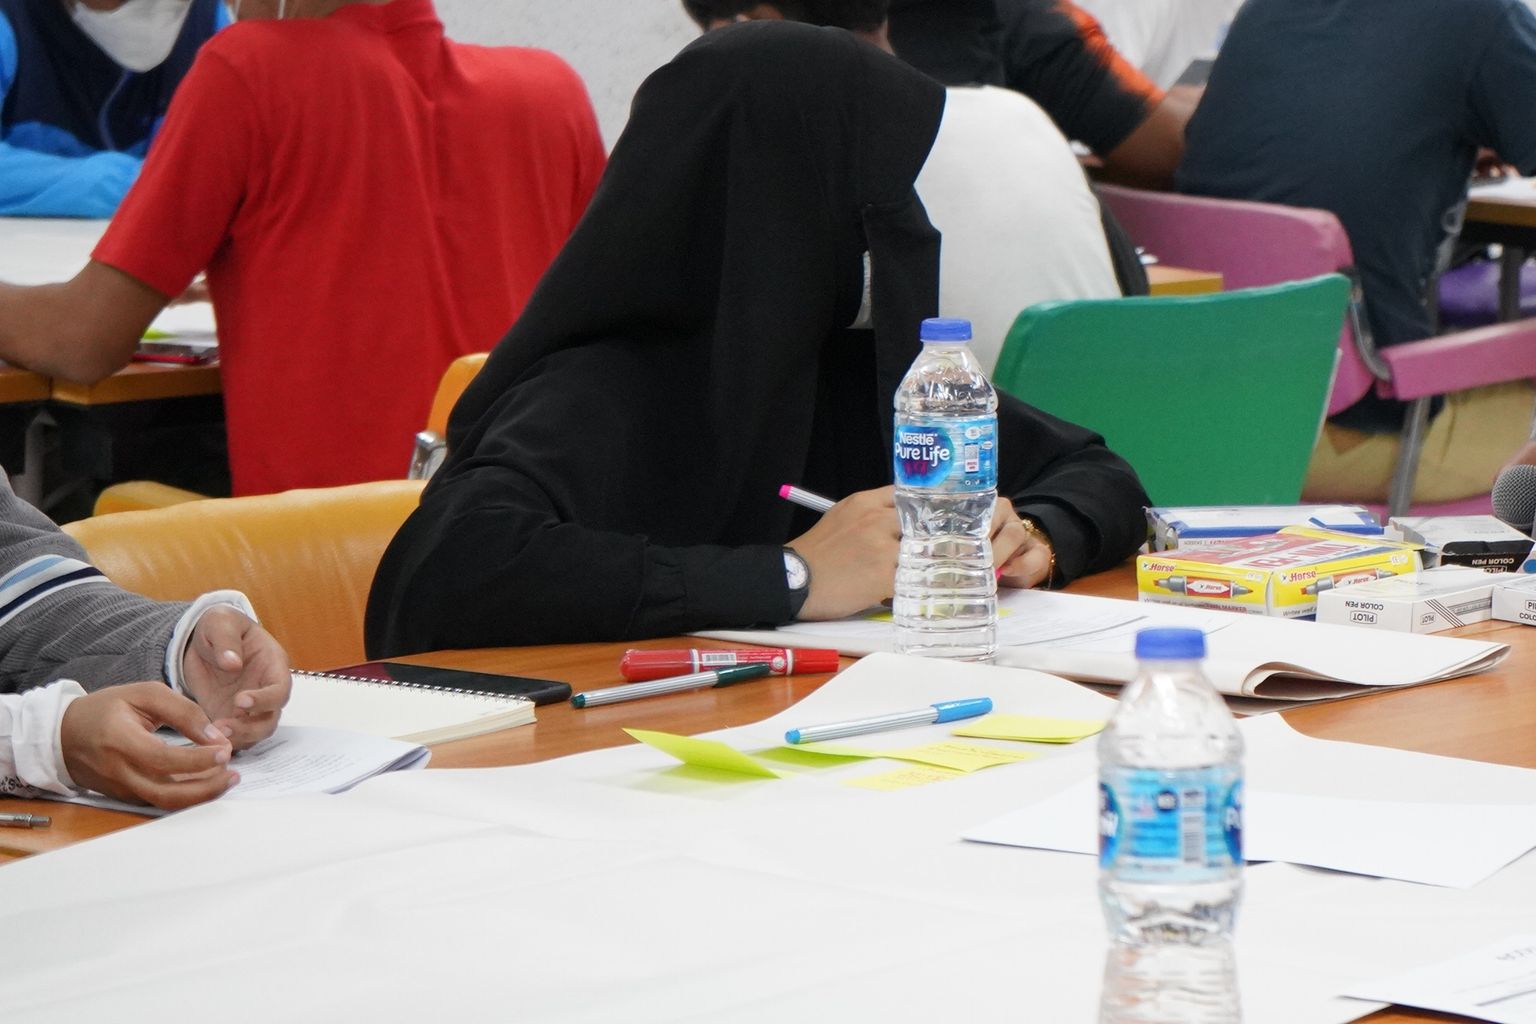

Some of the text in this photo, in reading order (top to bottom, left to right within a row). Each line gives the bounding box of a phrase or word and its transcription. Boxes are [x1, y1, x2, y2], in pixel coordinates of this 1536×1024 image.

[895, 443, 920, 460] Pure
[922, 445, 950, 467] Life
[1148, 562, 1176, 573] Horse
[1289, 570, 1317, 582] Horse
[1344, 600, 1385, 611] COLOR PEN
[1352, 612, 1376, 623] PILOT
[1421, 614, 1436, 624] PILOT
